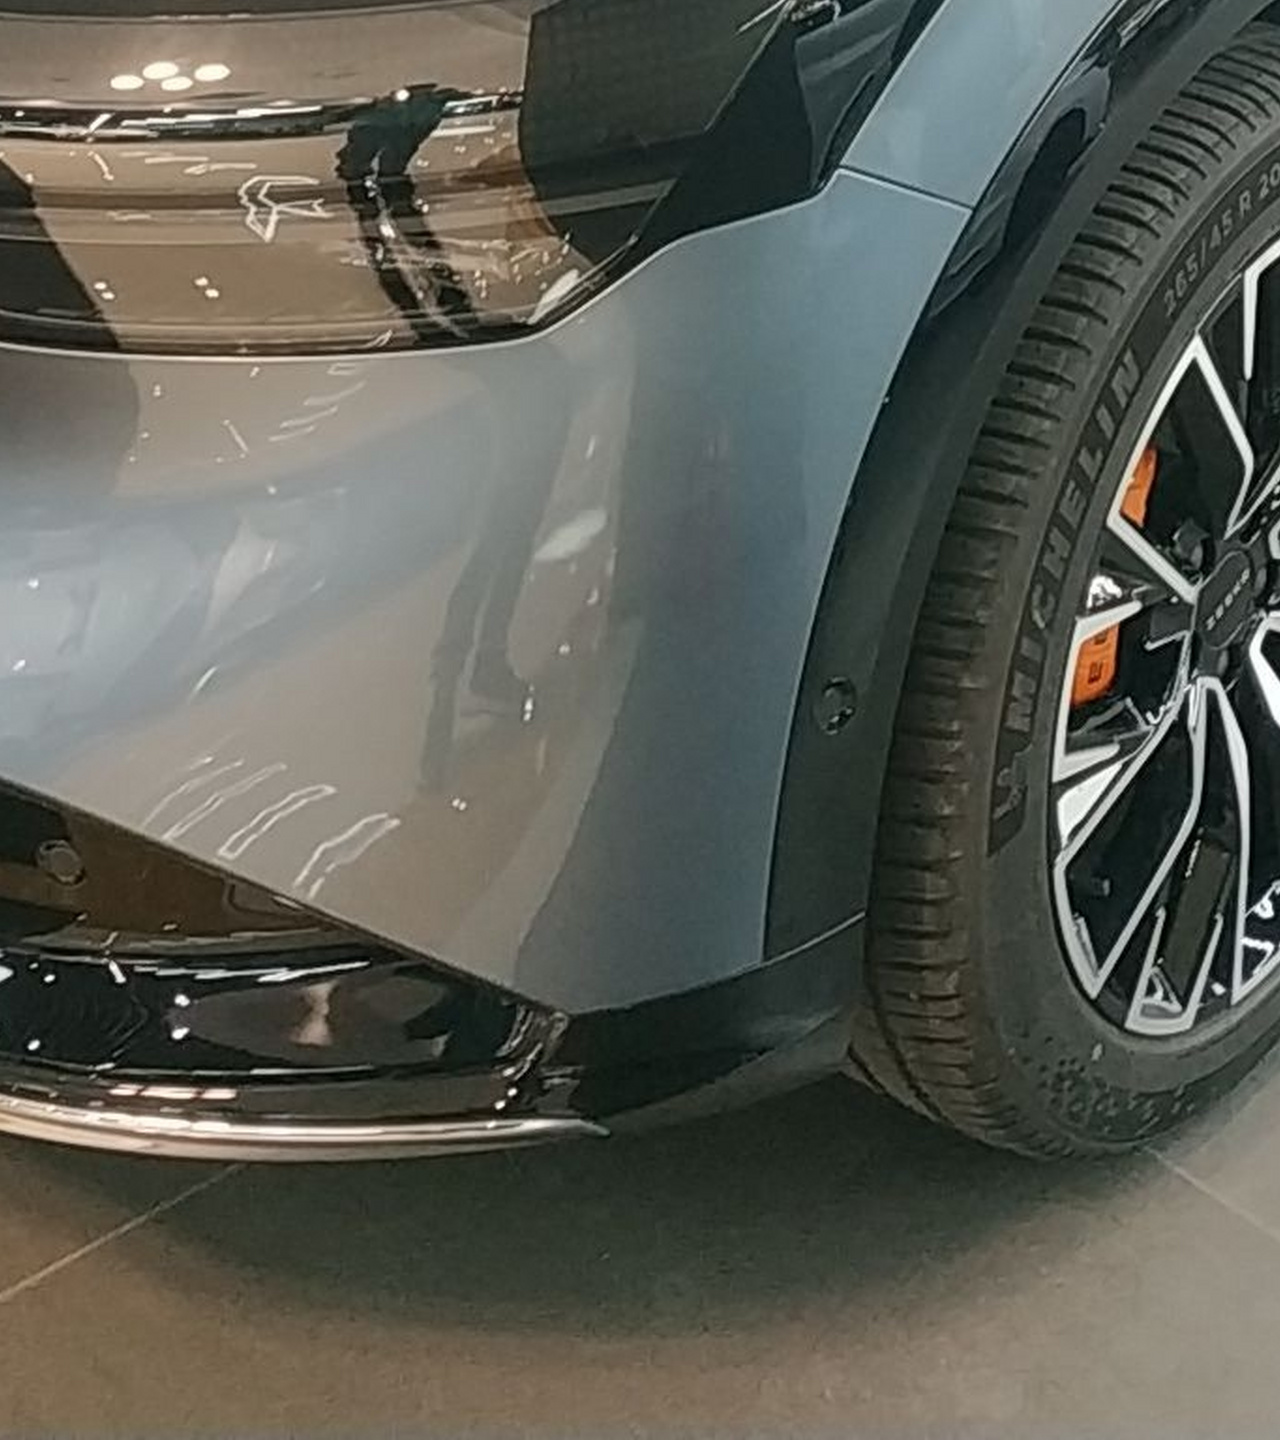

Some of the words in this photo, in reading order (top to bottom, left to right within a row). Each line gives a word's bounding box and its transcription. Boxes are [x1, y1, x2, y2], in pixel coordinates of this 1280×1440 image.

[1164, 209, 1232, 317] 265/45
[1239, 189, 1252, 219] R
[1006, 345, 1141, 733] MICHELIN
